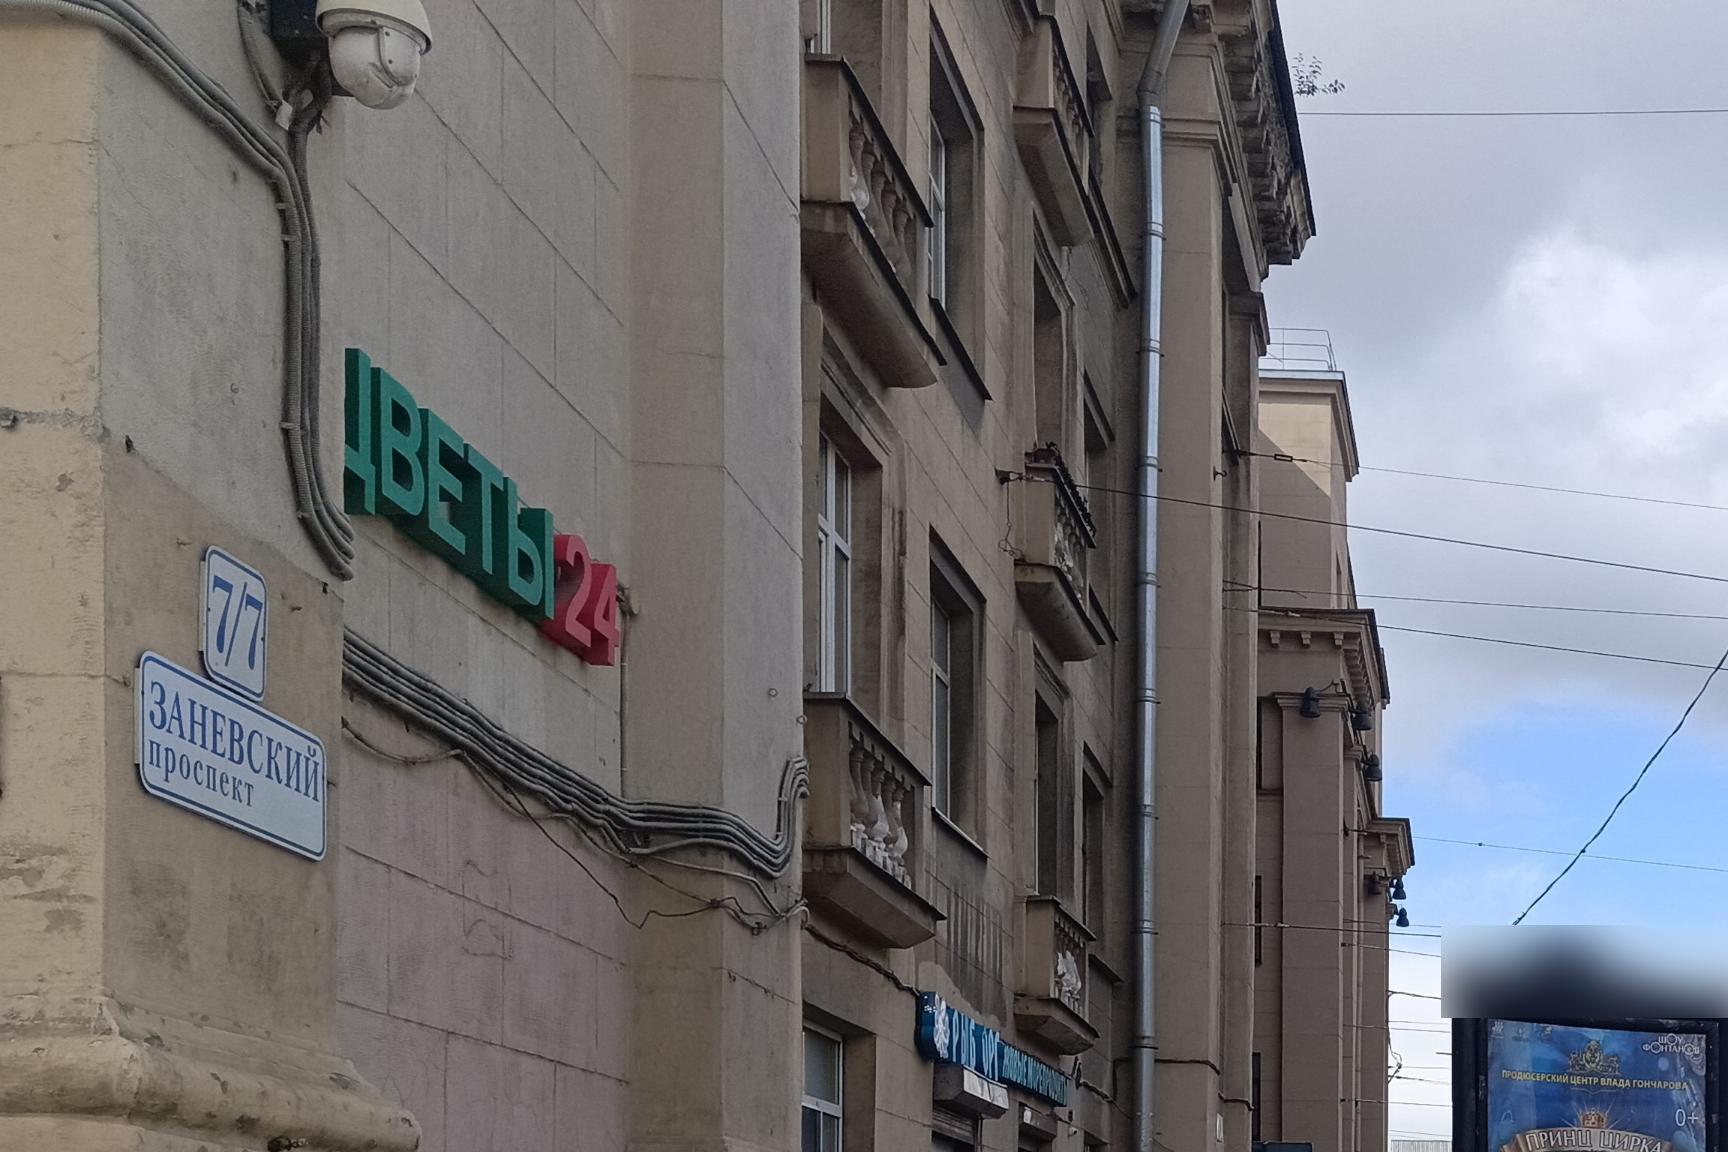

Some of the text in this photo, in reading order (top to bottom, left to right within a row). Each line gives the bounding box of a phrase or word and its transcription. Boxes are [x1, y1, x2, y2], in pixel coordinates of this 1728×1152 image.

[212, 575, 264, 671] 7/7
[554, 534, 619, 666] 24
[149, 681, 320, 802] ЗАНЕВСКИЙ
[149, 739, 255, 808] проспект
[1658, 1033, 1684, 1045] ШОУ
[1502, 1070, 1688, 1091] ПРОДЮСЕРСКИЙ ЦЕНТР ВЛАДА ГОНЧАРОВА
[1525, 1129, 1593, 1152] ПРИНЦ
[1676, 1109, 1699, 1126] 0+
